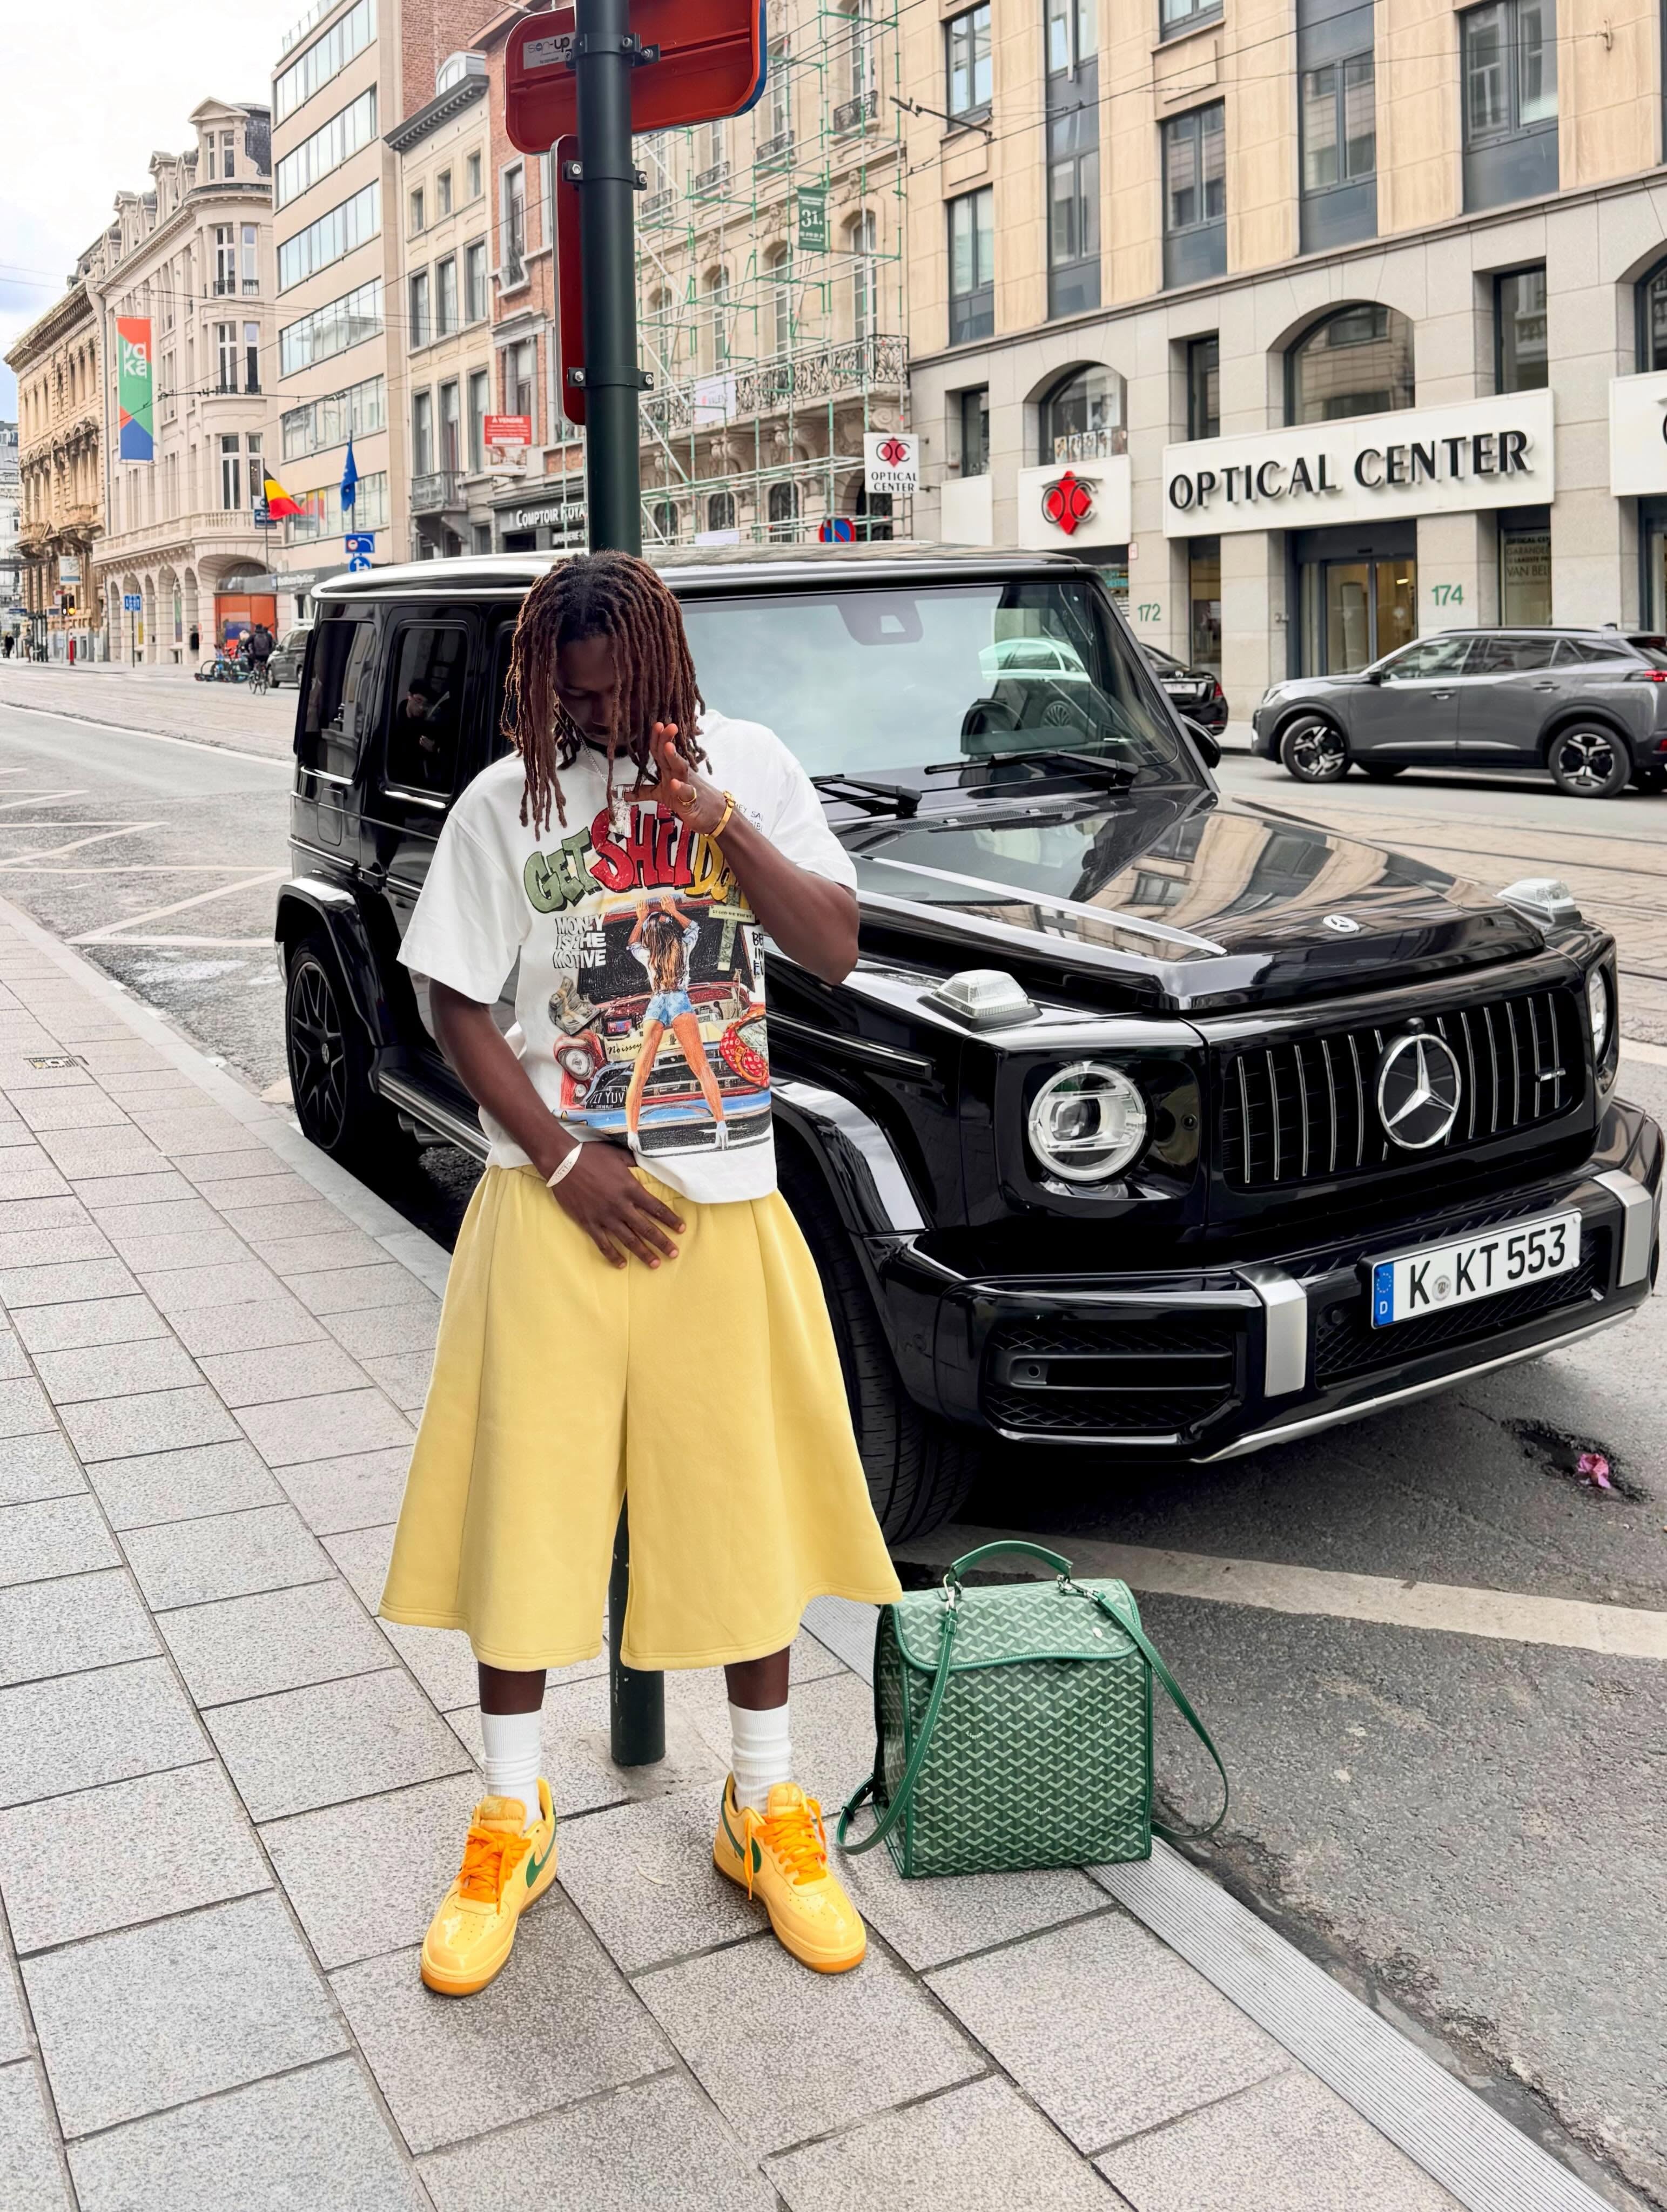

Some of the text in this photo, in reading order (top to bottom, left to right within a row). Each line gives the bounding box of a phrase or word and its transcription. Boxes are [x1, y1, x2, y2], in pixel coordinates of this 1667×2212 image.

[871, 471, 917, 482] OPTICAL
[1169, 430, 1530, 510] OPTICAL CENTER
[873, 482, 914, 492] CENTER
[1506, 565, 1529, 577] VAN
[1431, 584, 1464, 606] 174
[1137, 603, 1161, 621] 172
[524, 827, 602, 914] GET
[555, 913, 605, 935] MONEY
[553, 949, 606, 969] MOTIVE
[606, 1091, 624, 1104] YUV
[1409, 1223, 1566, 1309] K KT 553
[1379, 1300, 1388, 1315] D
